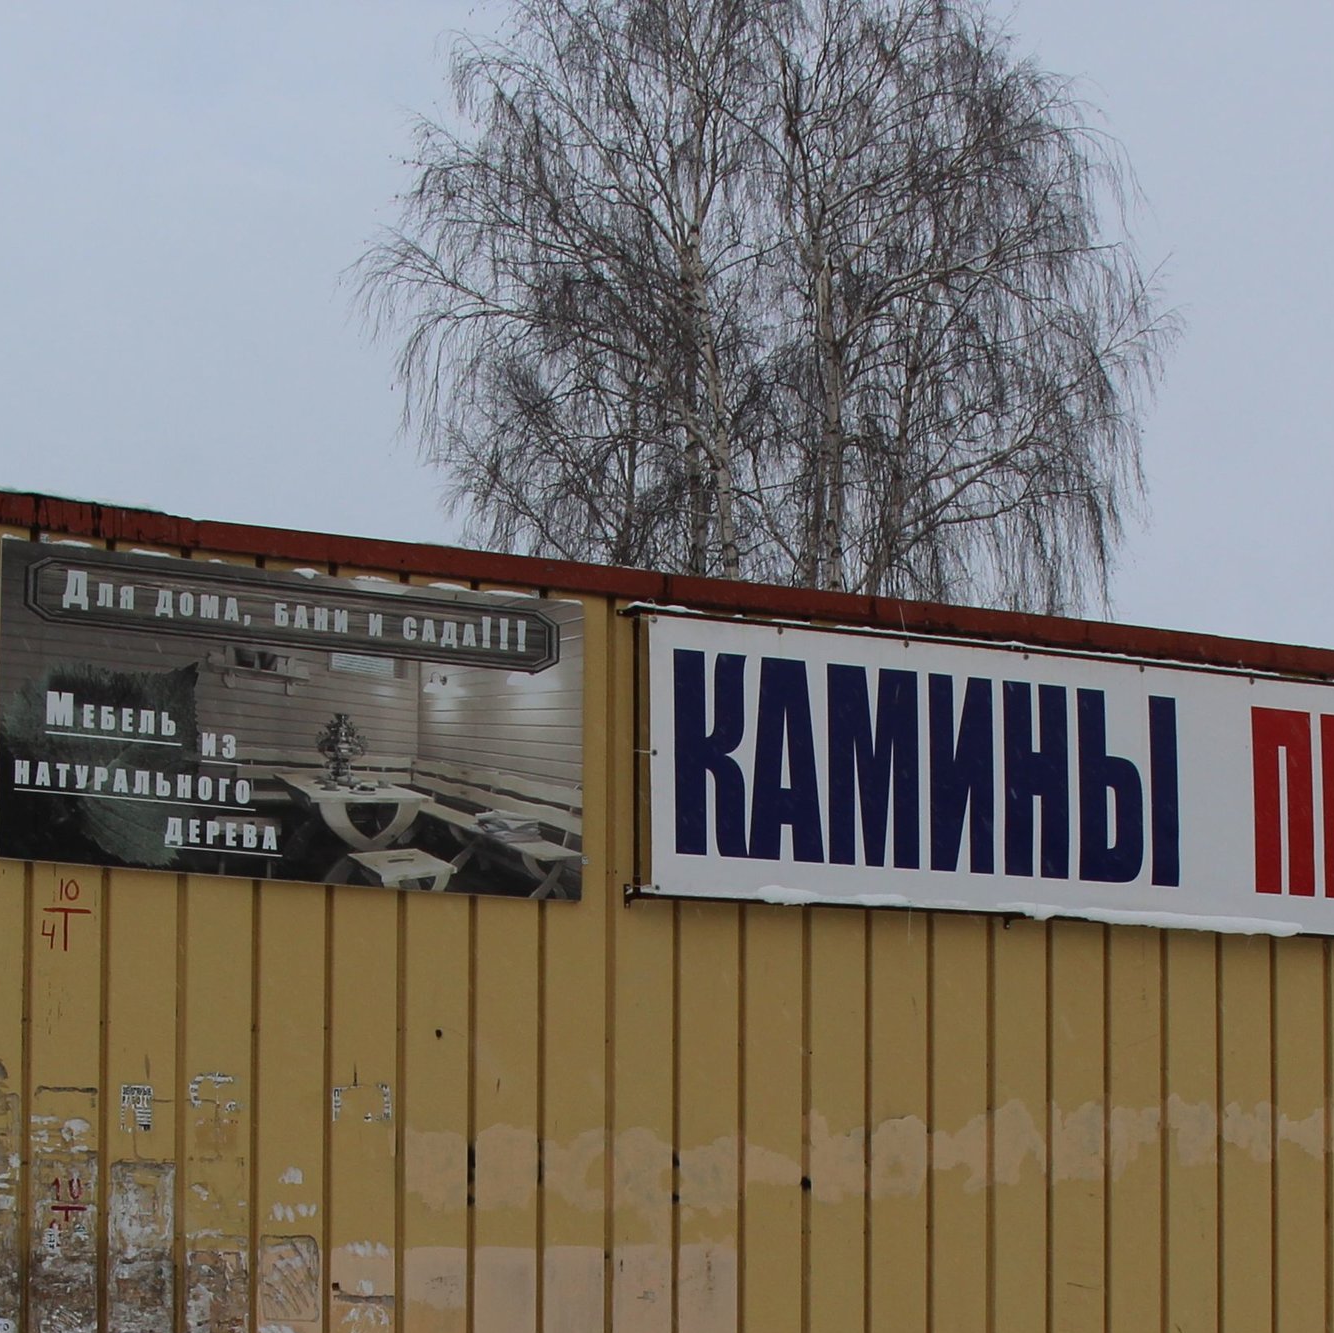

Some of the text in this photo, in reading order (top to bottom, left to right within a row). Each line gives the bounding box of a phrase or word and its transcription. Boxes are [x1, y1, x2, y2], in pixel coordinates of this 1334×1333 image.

[274, 602, 349, 635] БАНИ
[368, 612, 383, 638] И
[46, 691, 178, 738] МЕБЕЛЬ
[201, 731, 237, 760] ИЗ
[14, 758, 252, 804] НАТУРАЛЬНОГО
[672, 648, 1180, 888] КАМИНЫ
[165, 816, 278, 852] ДЕРЕВА
[58, 878, 80, 901] 10
